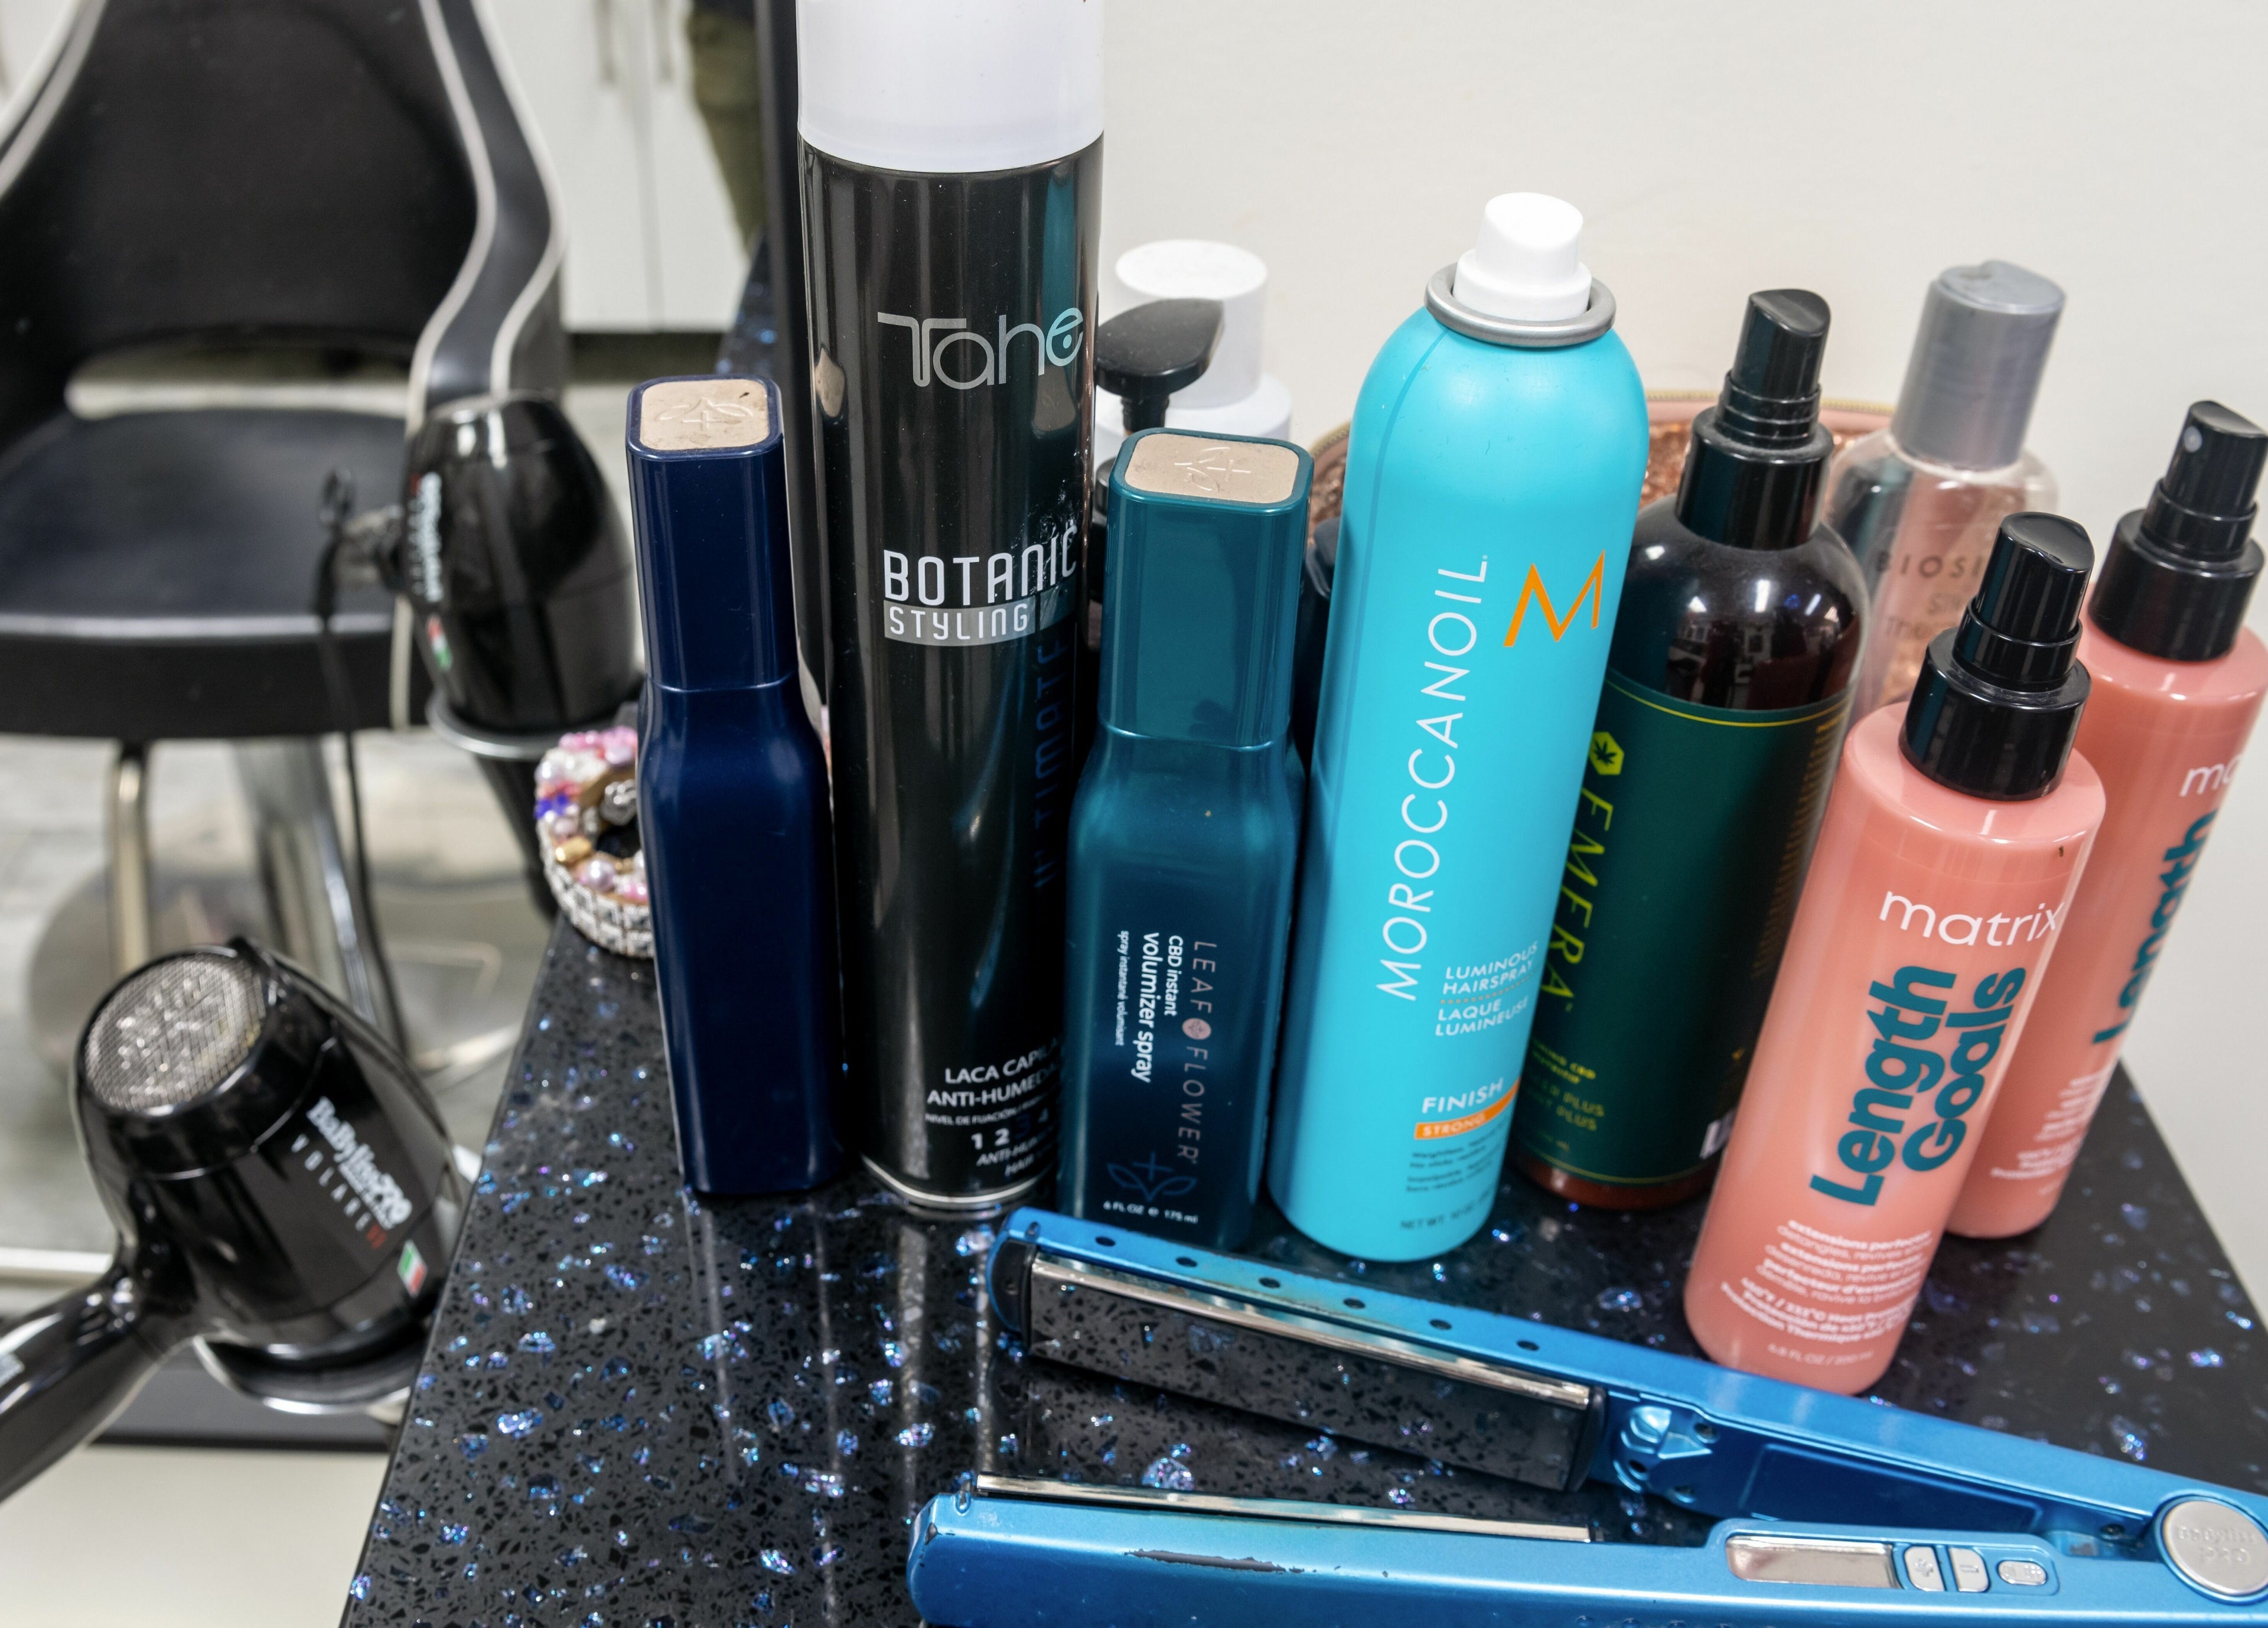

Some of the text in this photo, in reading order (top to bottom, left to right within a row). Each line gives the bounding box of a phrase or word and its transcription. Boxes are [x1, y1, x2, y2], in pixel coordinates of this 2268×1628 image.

[878, 308, 1083, 390] Tahe
[884, 526, 1077, 606] BOTANIC
[889, 603, 1028, 640] STYLING
[1503, 549, 1606, 647] M
[1376, 560, 1488, 1001] MOROCCANOIL
[1117, 930, 1129, 956] spray
[1879, 890, 2064, 946] matrix
[1164, 935, 1183, 1016] CBD instant
[1443, 959, 1532, 995] HAIRSPRAY
[1446, 941, 1537, 979] LUMINOUS
[1131, 932, 1163, 1083] volumizer spray
[1438, 998, 1501, 1021] LAQUE
[945, 1065, 1000, 1084] LACA
[1178, 940, 1217, 1159] LEAF FLOWER
[1902, 967, 2026, 1173] Goals
[1422, 1078, 1504, 1114] FINISH
[1810, 966, 1957, 1207] Length
[971, 1132, 983, 1150] 1
[995, 1128, 1010, 1147] 2
[1423, 1114, 1486, 1137] STRONG
